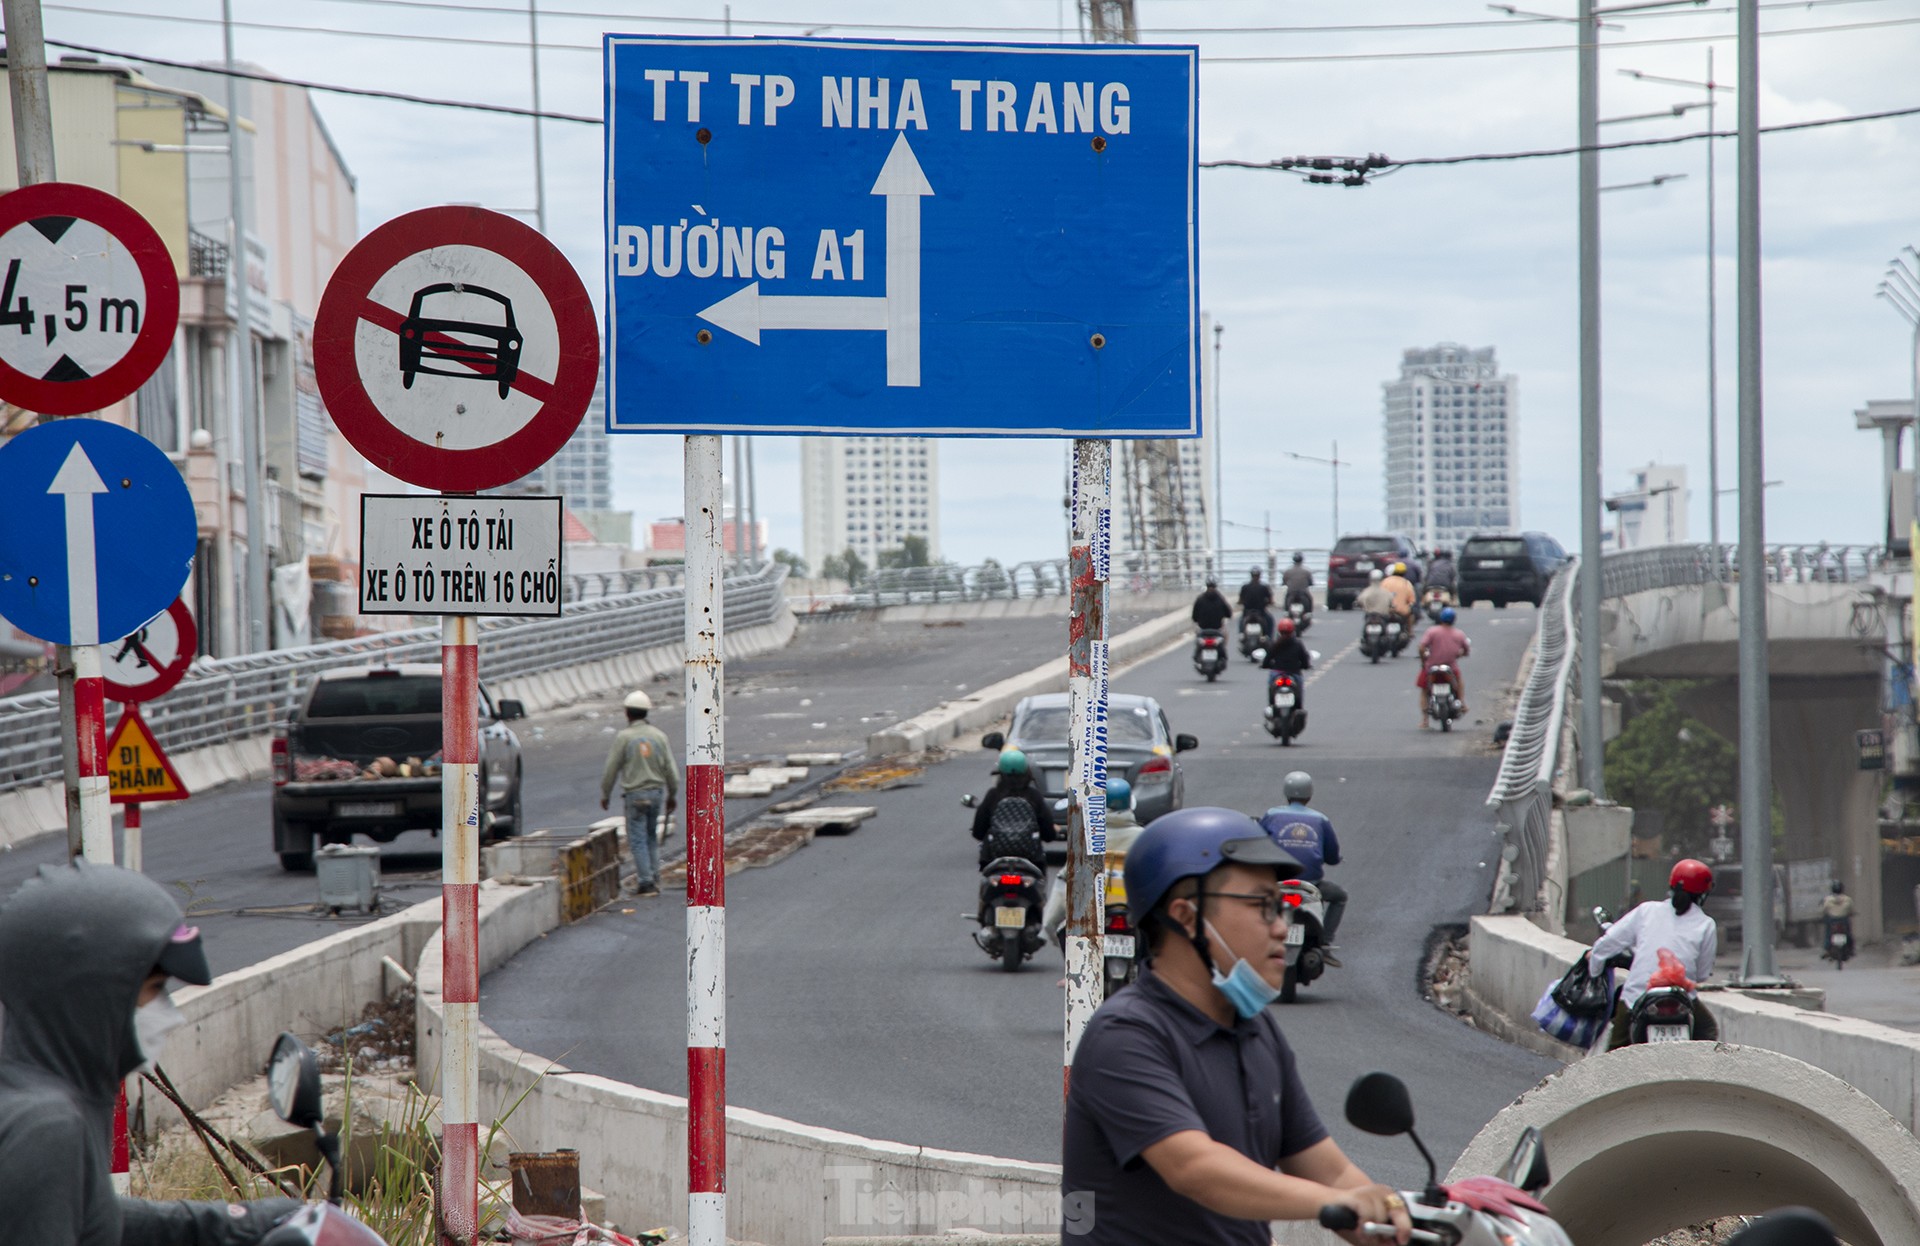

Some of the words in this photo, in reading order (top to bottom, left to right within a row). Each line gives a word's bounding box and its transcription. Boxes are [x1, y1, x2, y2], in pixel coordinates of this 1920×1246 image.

[644, 69, 709, 122] TT
[731, 73, 795, 126] TP
[821, 76, 928, 131] NHA
[951, 79, 1131, 135] TRANG
[614, 205, 785, 279] ĐƯỜNG
[811, 229, 864, 281] A1
[412, 518, 433, 549] XE
[440, 509, 451, 550] Ô
[458, 509, 479, 550] TÔ
[486, 508, 513, 550] TẢI
[366, 569, 388, 602] XE
[395, 562, 406, 602] Ô
[413, 562, 435, 602] TÔ
[441, 562, 485, 602] TRÊN
[493, 571, 514, 603] 16
[520, 558, 557, 603] CHỖ
[121, 746, 139, 765] ĐI
